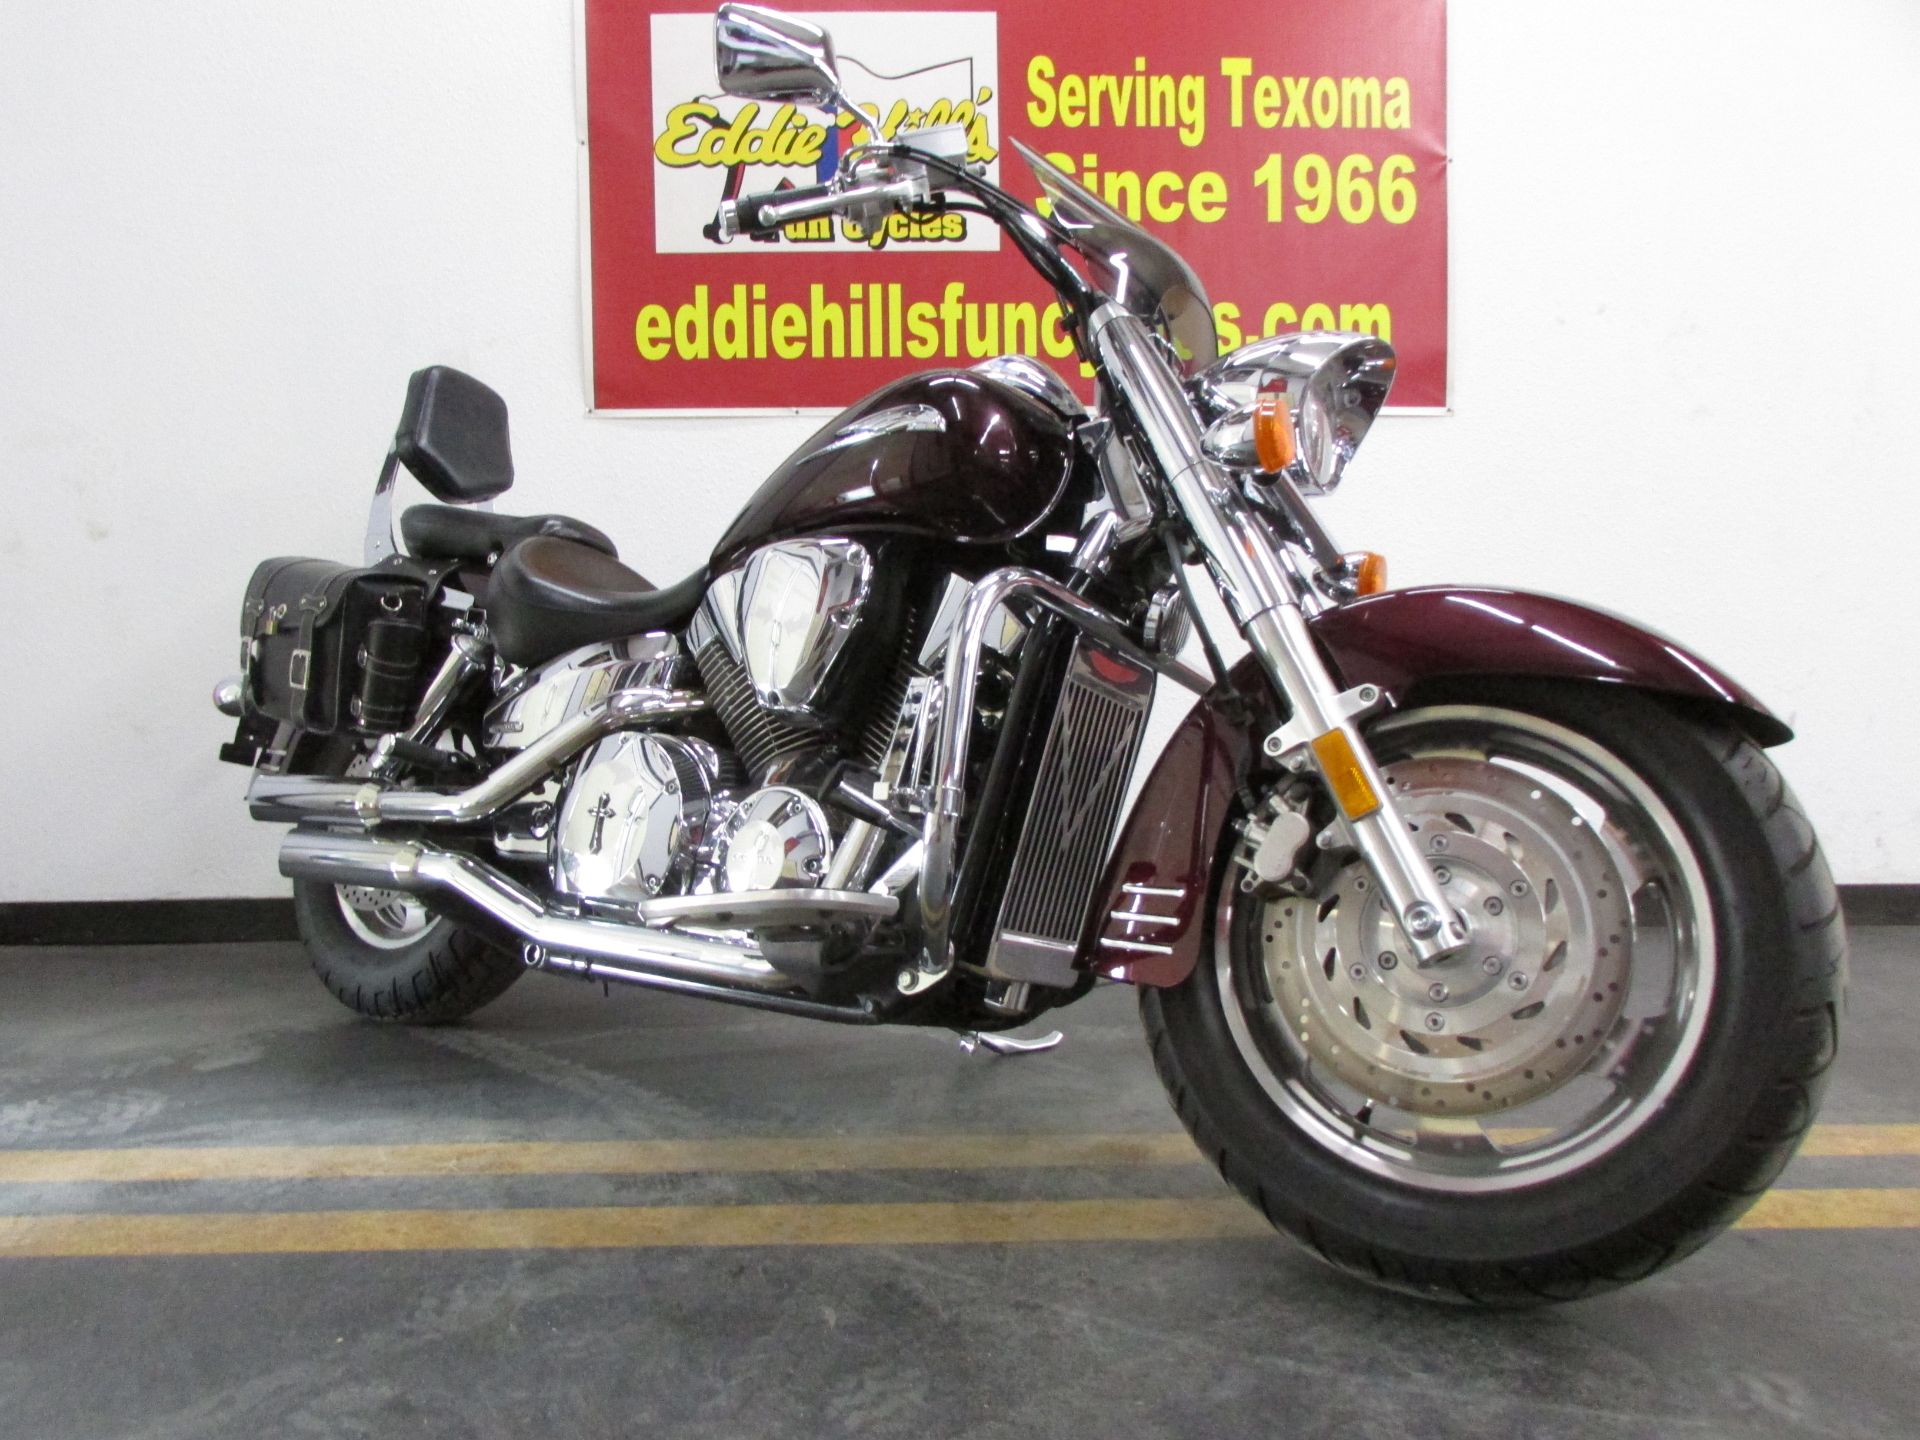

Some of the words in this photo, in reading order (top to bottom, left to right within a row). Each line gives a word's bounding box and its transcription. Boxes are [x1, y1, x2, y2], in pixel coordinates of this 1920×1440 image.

[655, 102, 827, 167] Eddie
[1027, 55, 1205, 147] Serving
[1221, 57, 1411, 129] Texoma
[1254, 153, 1418, 224] 1966
